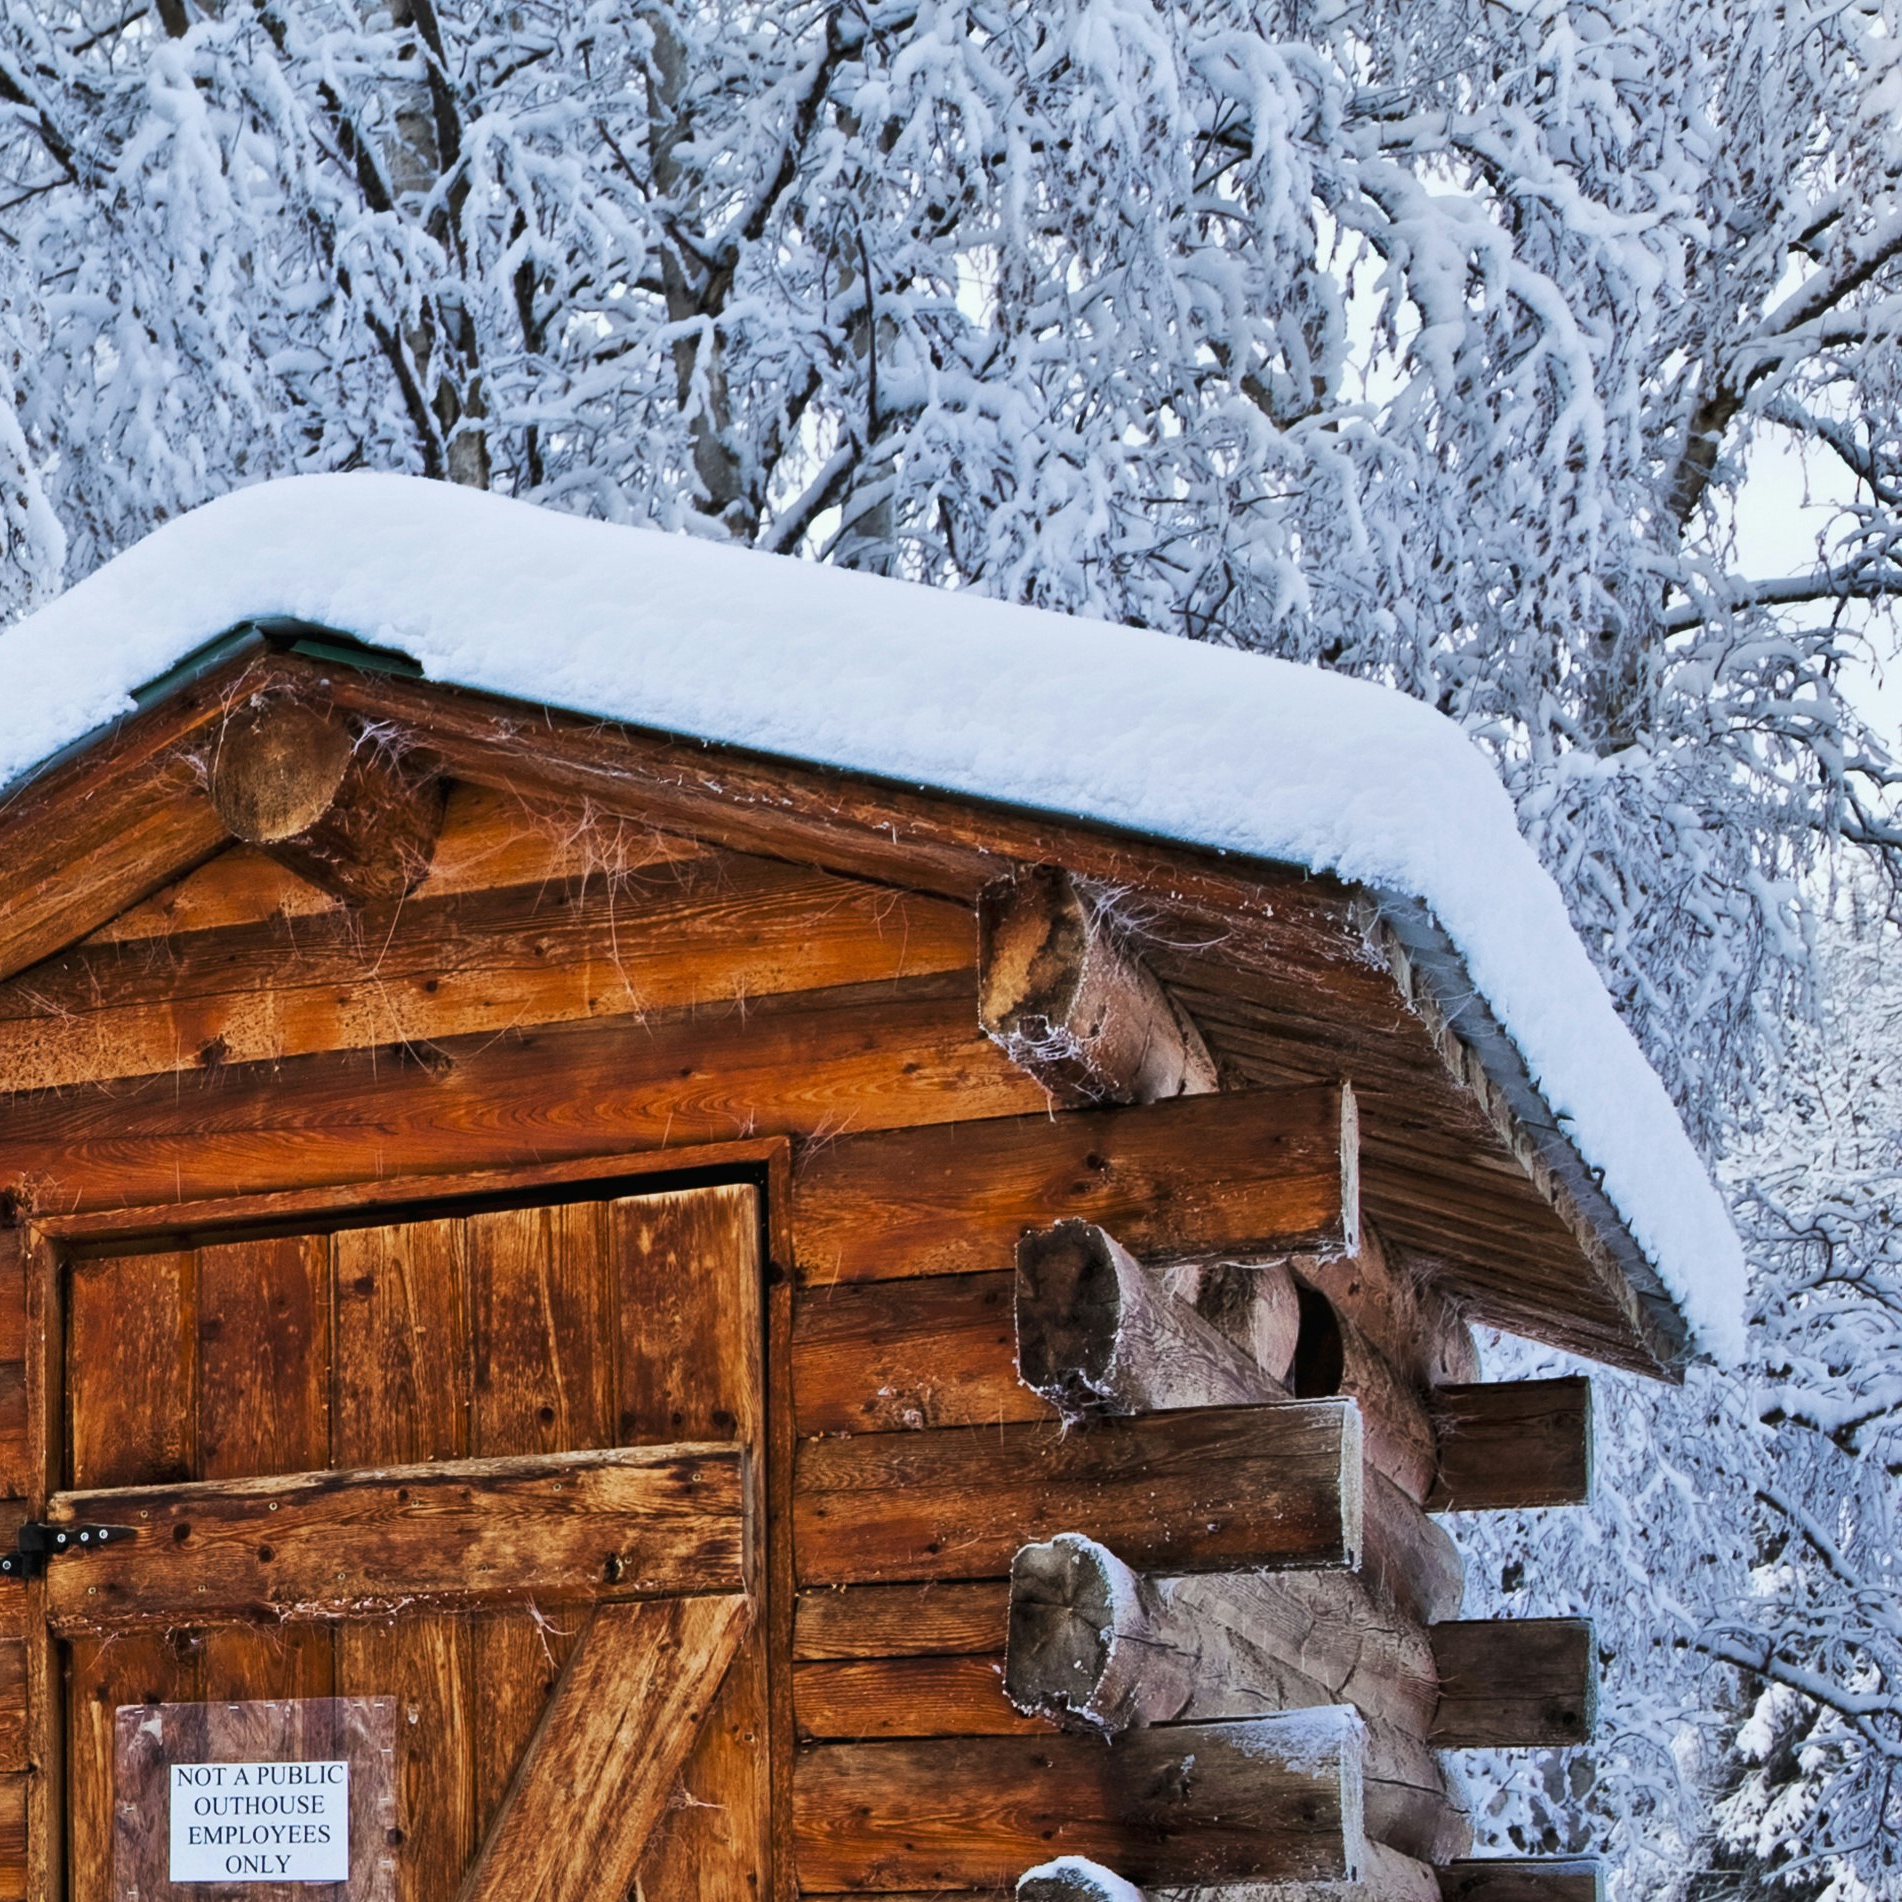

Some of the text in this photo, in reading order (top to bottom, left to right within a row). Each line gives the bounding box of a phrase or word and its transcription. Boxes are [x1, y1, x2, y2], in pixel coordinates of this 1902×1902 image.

[177, 1765, 344, 1786] NOT A PUBLIC
[194, 1795, 325, 1816] OUTHOUSE
[188, 1824, 331, 1845] EMPLOYEES
[225, 1854, 292, 1874] ONLY
